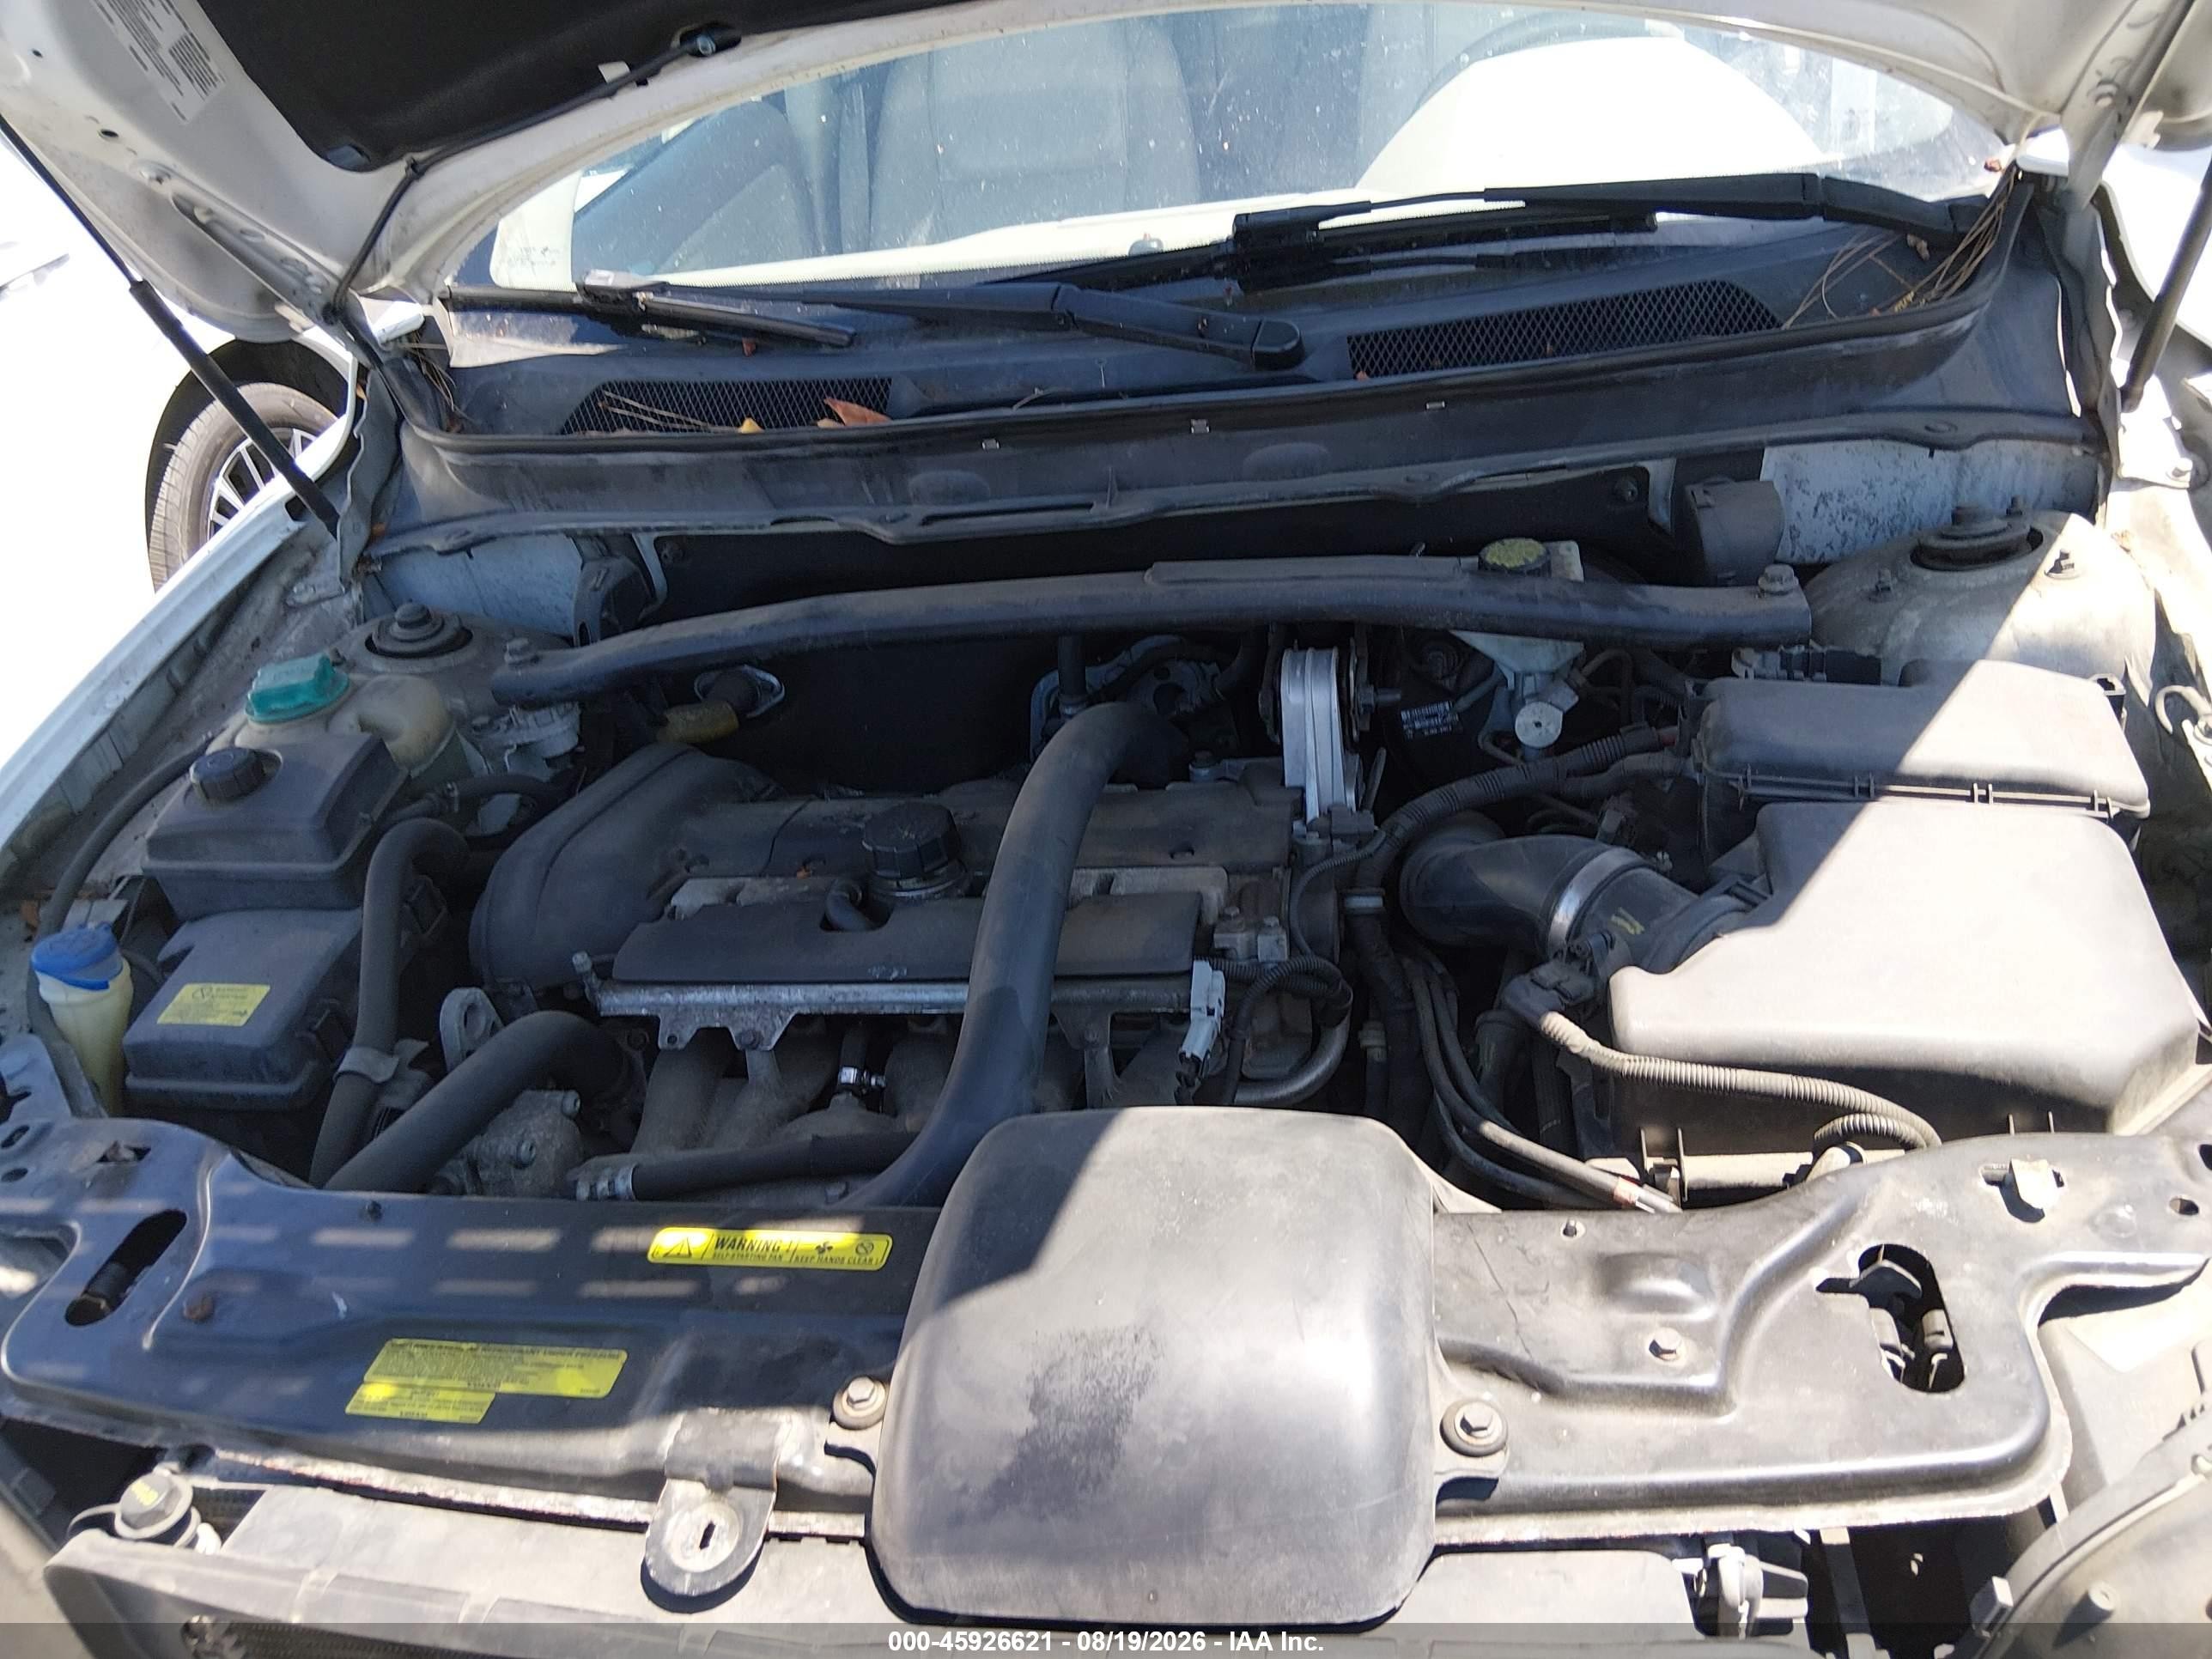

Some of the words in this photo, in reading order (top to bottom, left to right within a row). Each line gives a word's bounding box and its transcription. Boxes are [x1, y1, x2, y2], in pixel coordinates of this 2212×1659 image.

[714, 1237, 782, 1252] WARNING
[793, 1255, 814, 1264] KEEP
[817, 1255, 845, 1265] HANDS
[847, 1255, 873, 1265] CLEAR
